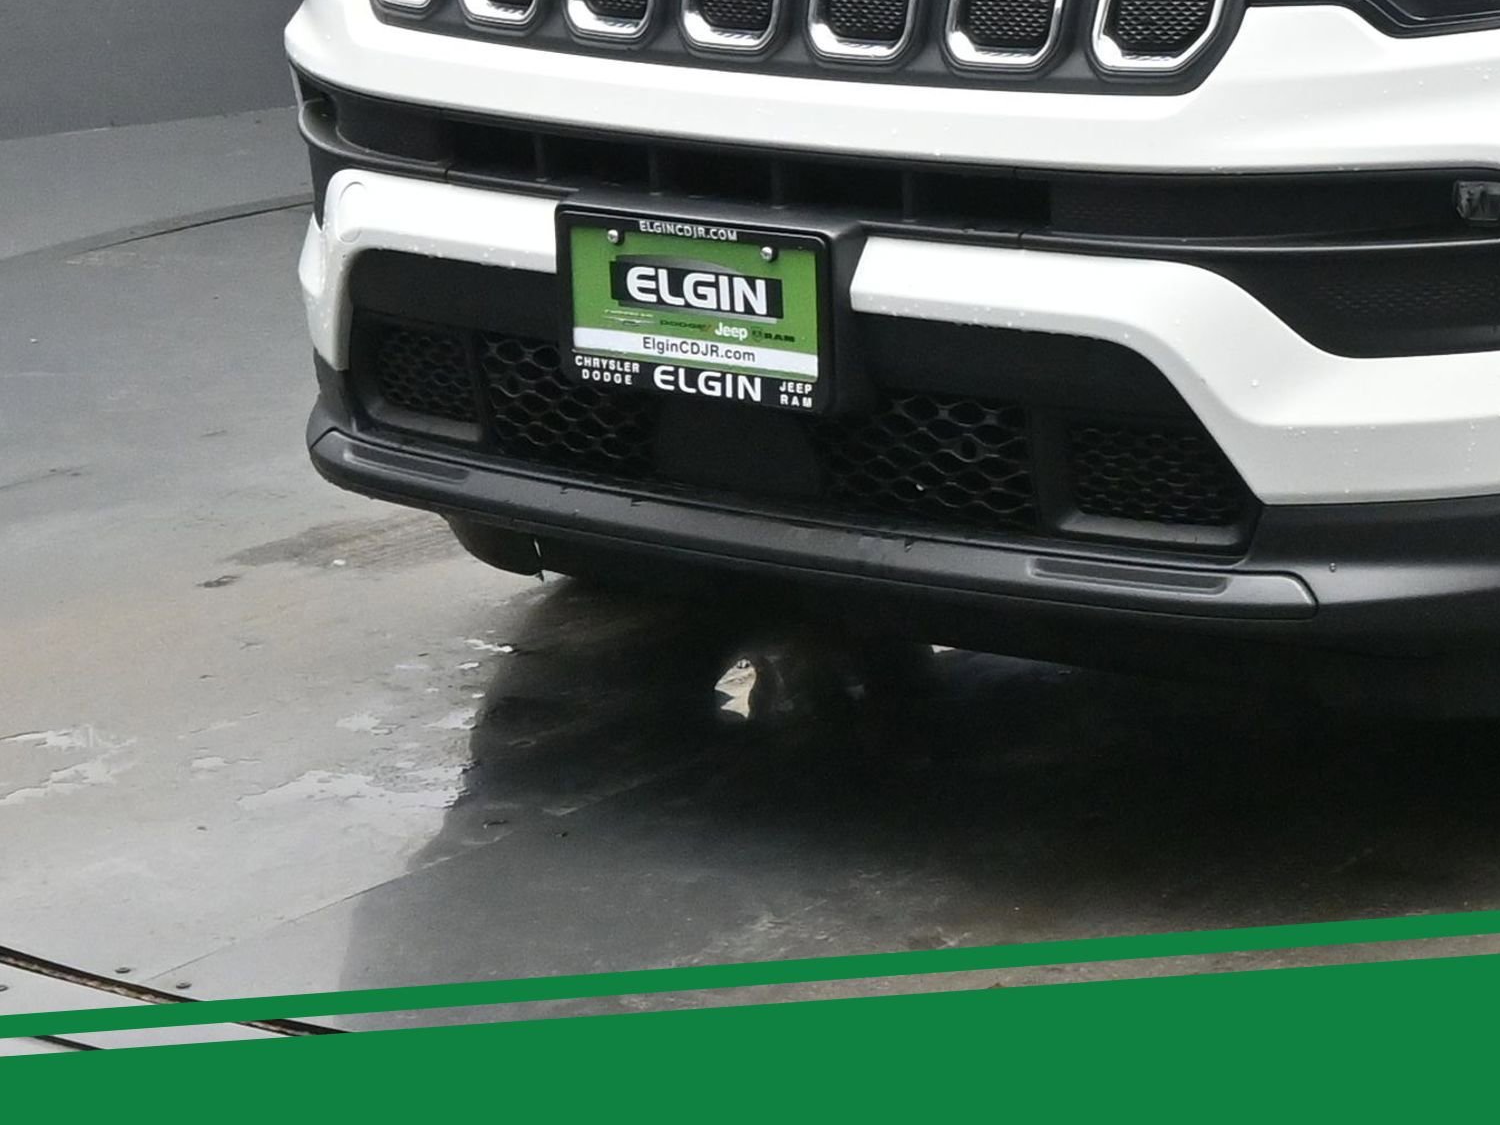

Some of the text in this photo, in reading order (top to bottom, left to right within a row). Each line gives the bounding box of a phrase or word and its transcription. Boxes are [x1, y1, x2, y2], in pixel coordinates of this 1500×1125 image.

[639, 220, 738, 242] ELGINCDJR.COM
[626, 266, 768, 315] ELGIN
[714, 322, 749, 341] Jeep
[764, 332, 796, 343] RAM
[643, 336, 756, 363] ElginCDJR.com
[575, 355, 640, 374] CHRYSLER
[582, 368, 633, 385] DODGE
[653, 366, 762, 402] ELGIN
[779, 381, 813, 395] JEEP
[779, 394, 813, 409] RAM
